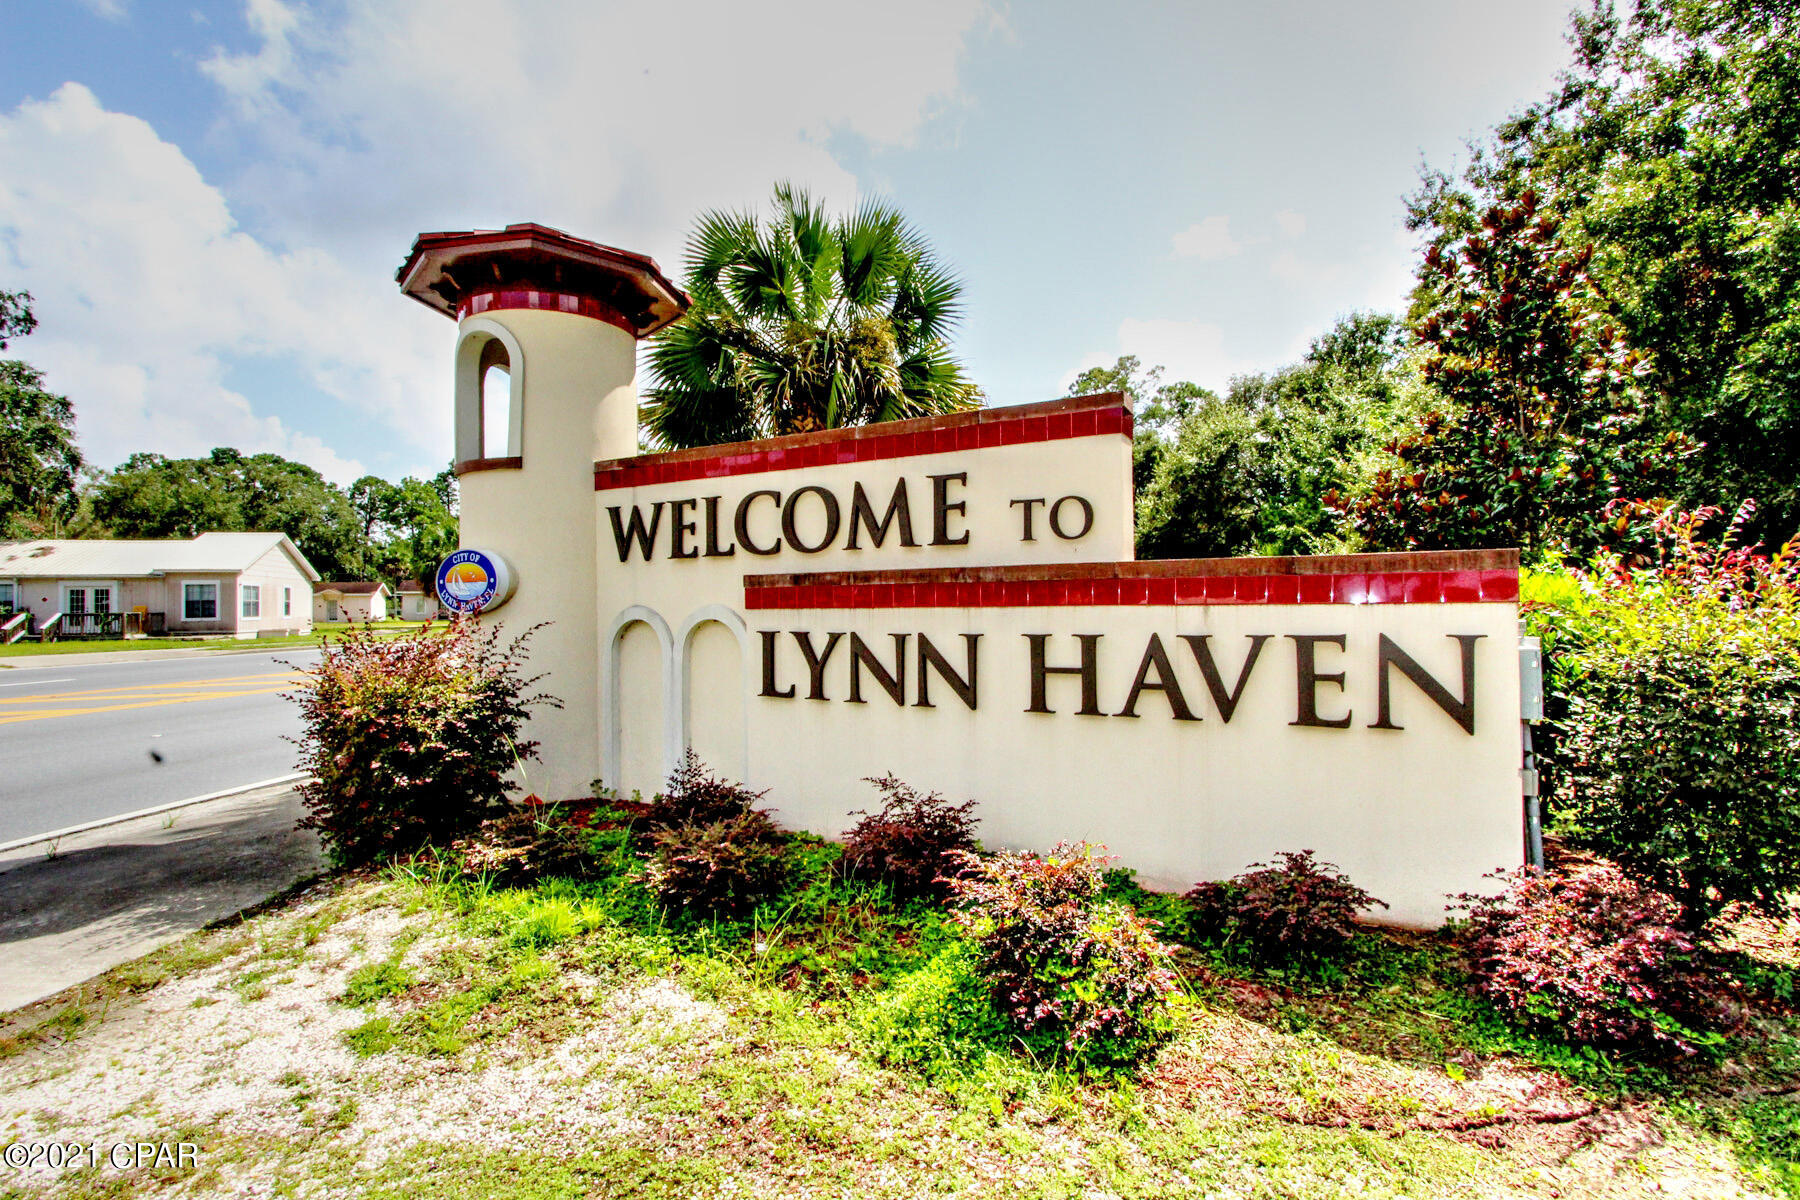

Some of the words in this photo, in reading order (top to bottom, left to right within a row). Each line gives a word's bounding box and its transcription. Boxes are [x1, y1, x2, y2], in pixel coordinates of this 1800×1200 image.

[606, 471, 969, 563] WELCOME
[1009, 495, 1094, 541] TO
[452, 553, 469, 564] CITY
[469, 553, 480, 562] OF
[441, 590, 458, 608] LYNN
[757, 630, 983, 711] LYNN
[1021, 632, 1488, 736] HAVEN
